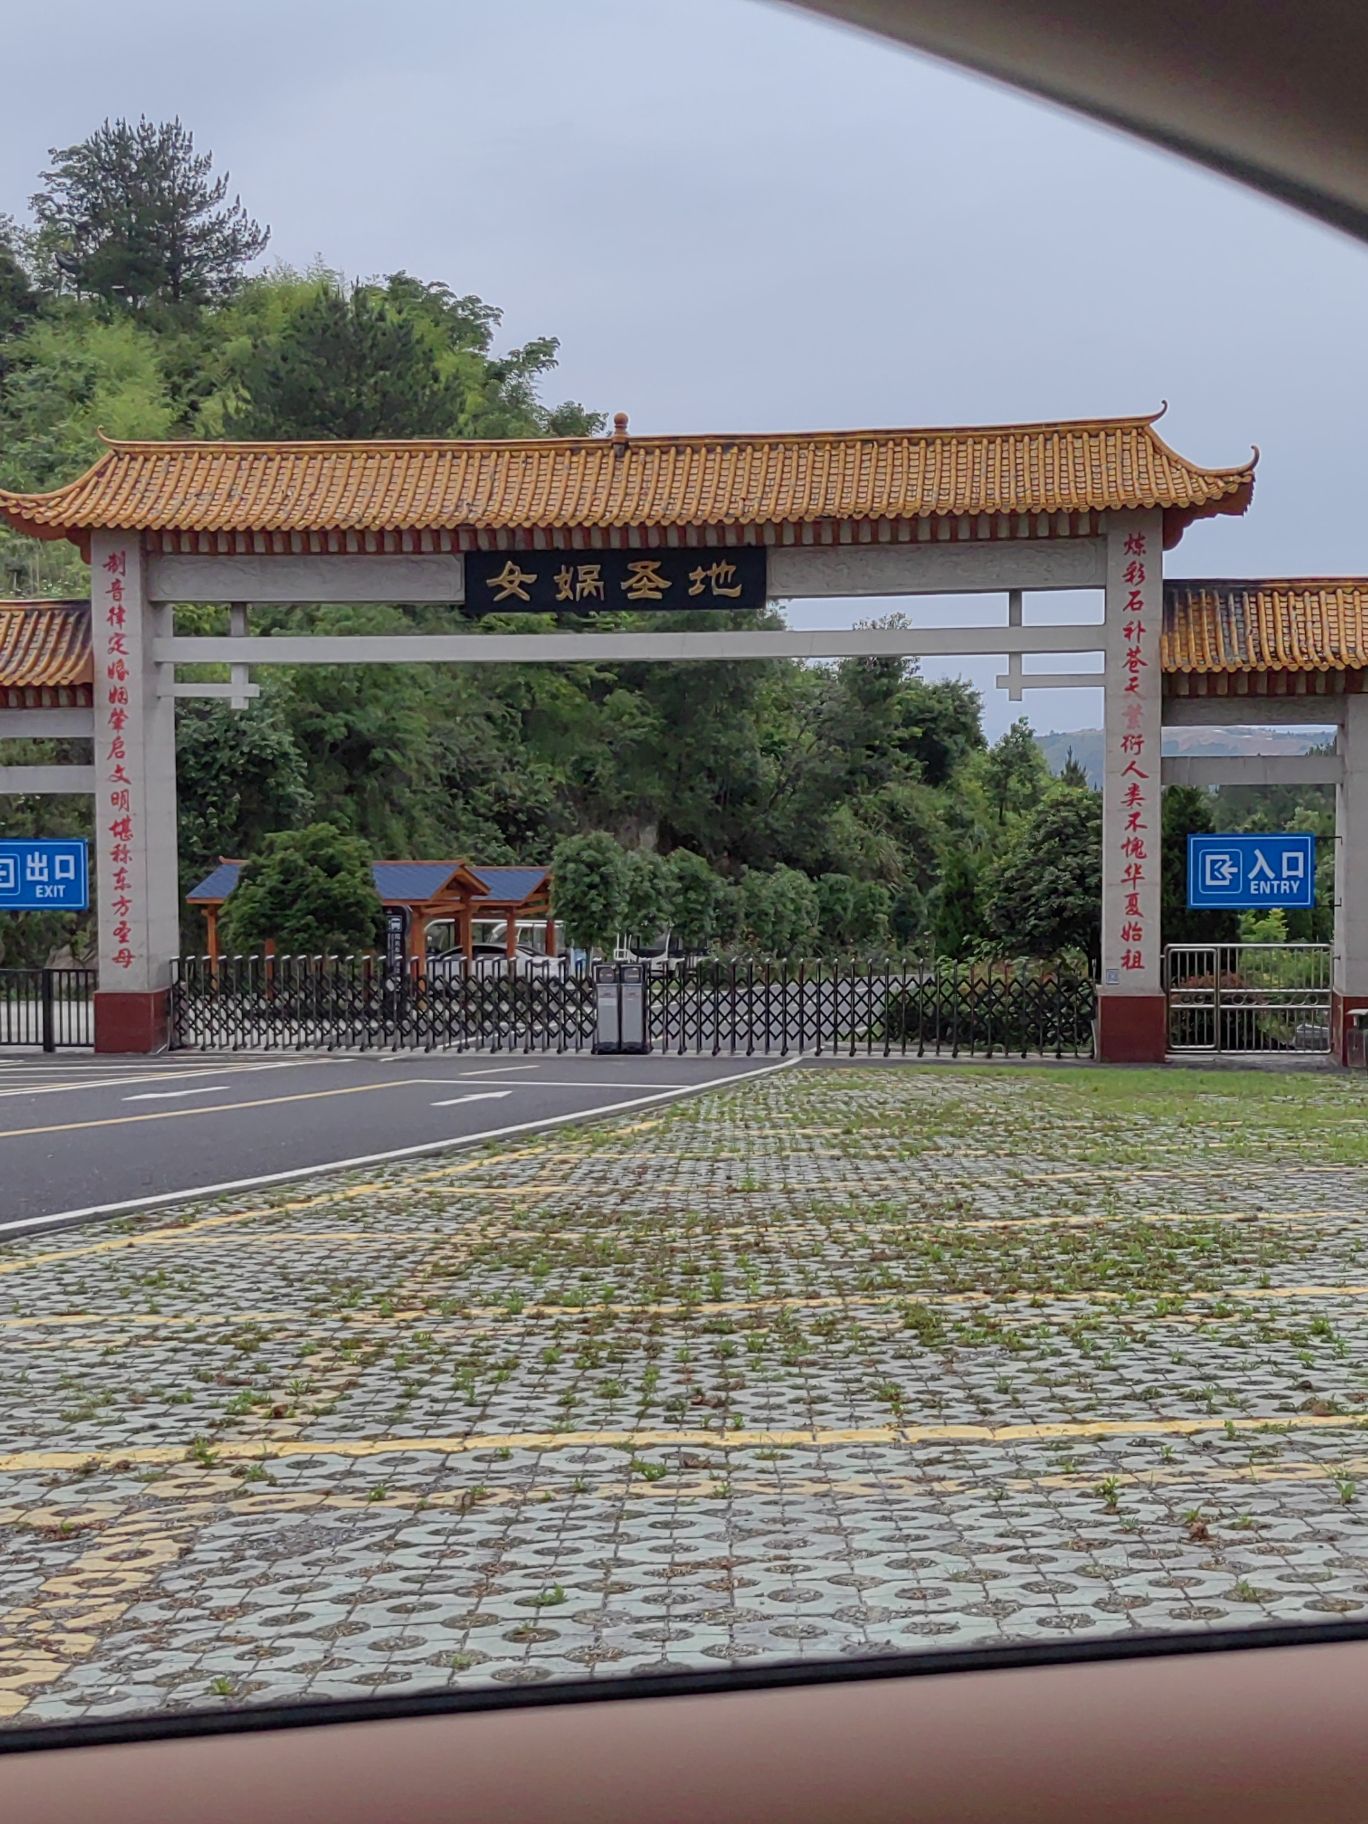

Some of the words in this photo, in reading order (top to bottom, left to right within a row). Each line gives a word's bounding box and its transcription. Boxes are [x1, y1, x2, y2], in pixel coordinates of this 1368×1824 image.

[486, 560, 743, 601] 女娲圣地
[26, 851, 75, 881] 出口
[1247, 848, 1304, 879] 入口
[35, 885, 66, 898] EXIT
[1249, 880, 1300, 894] ENTRY
